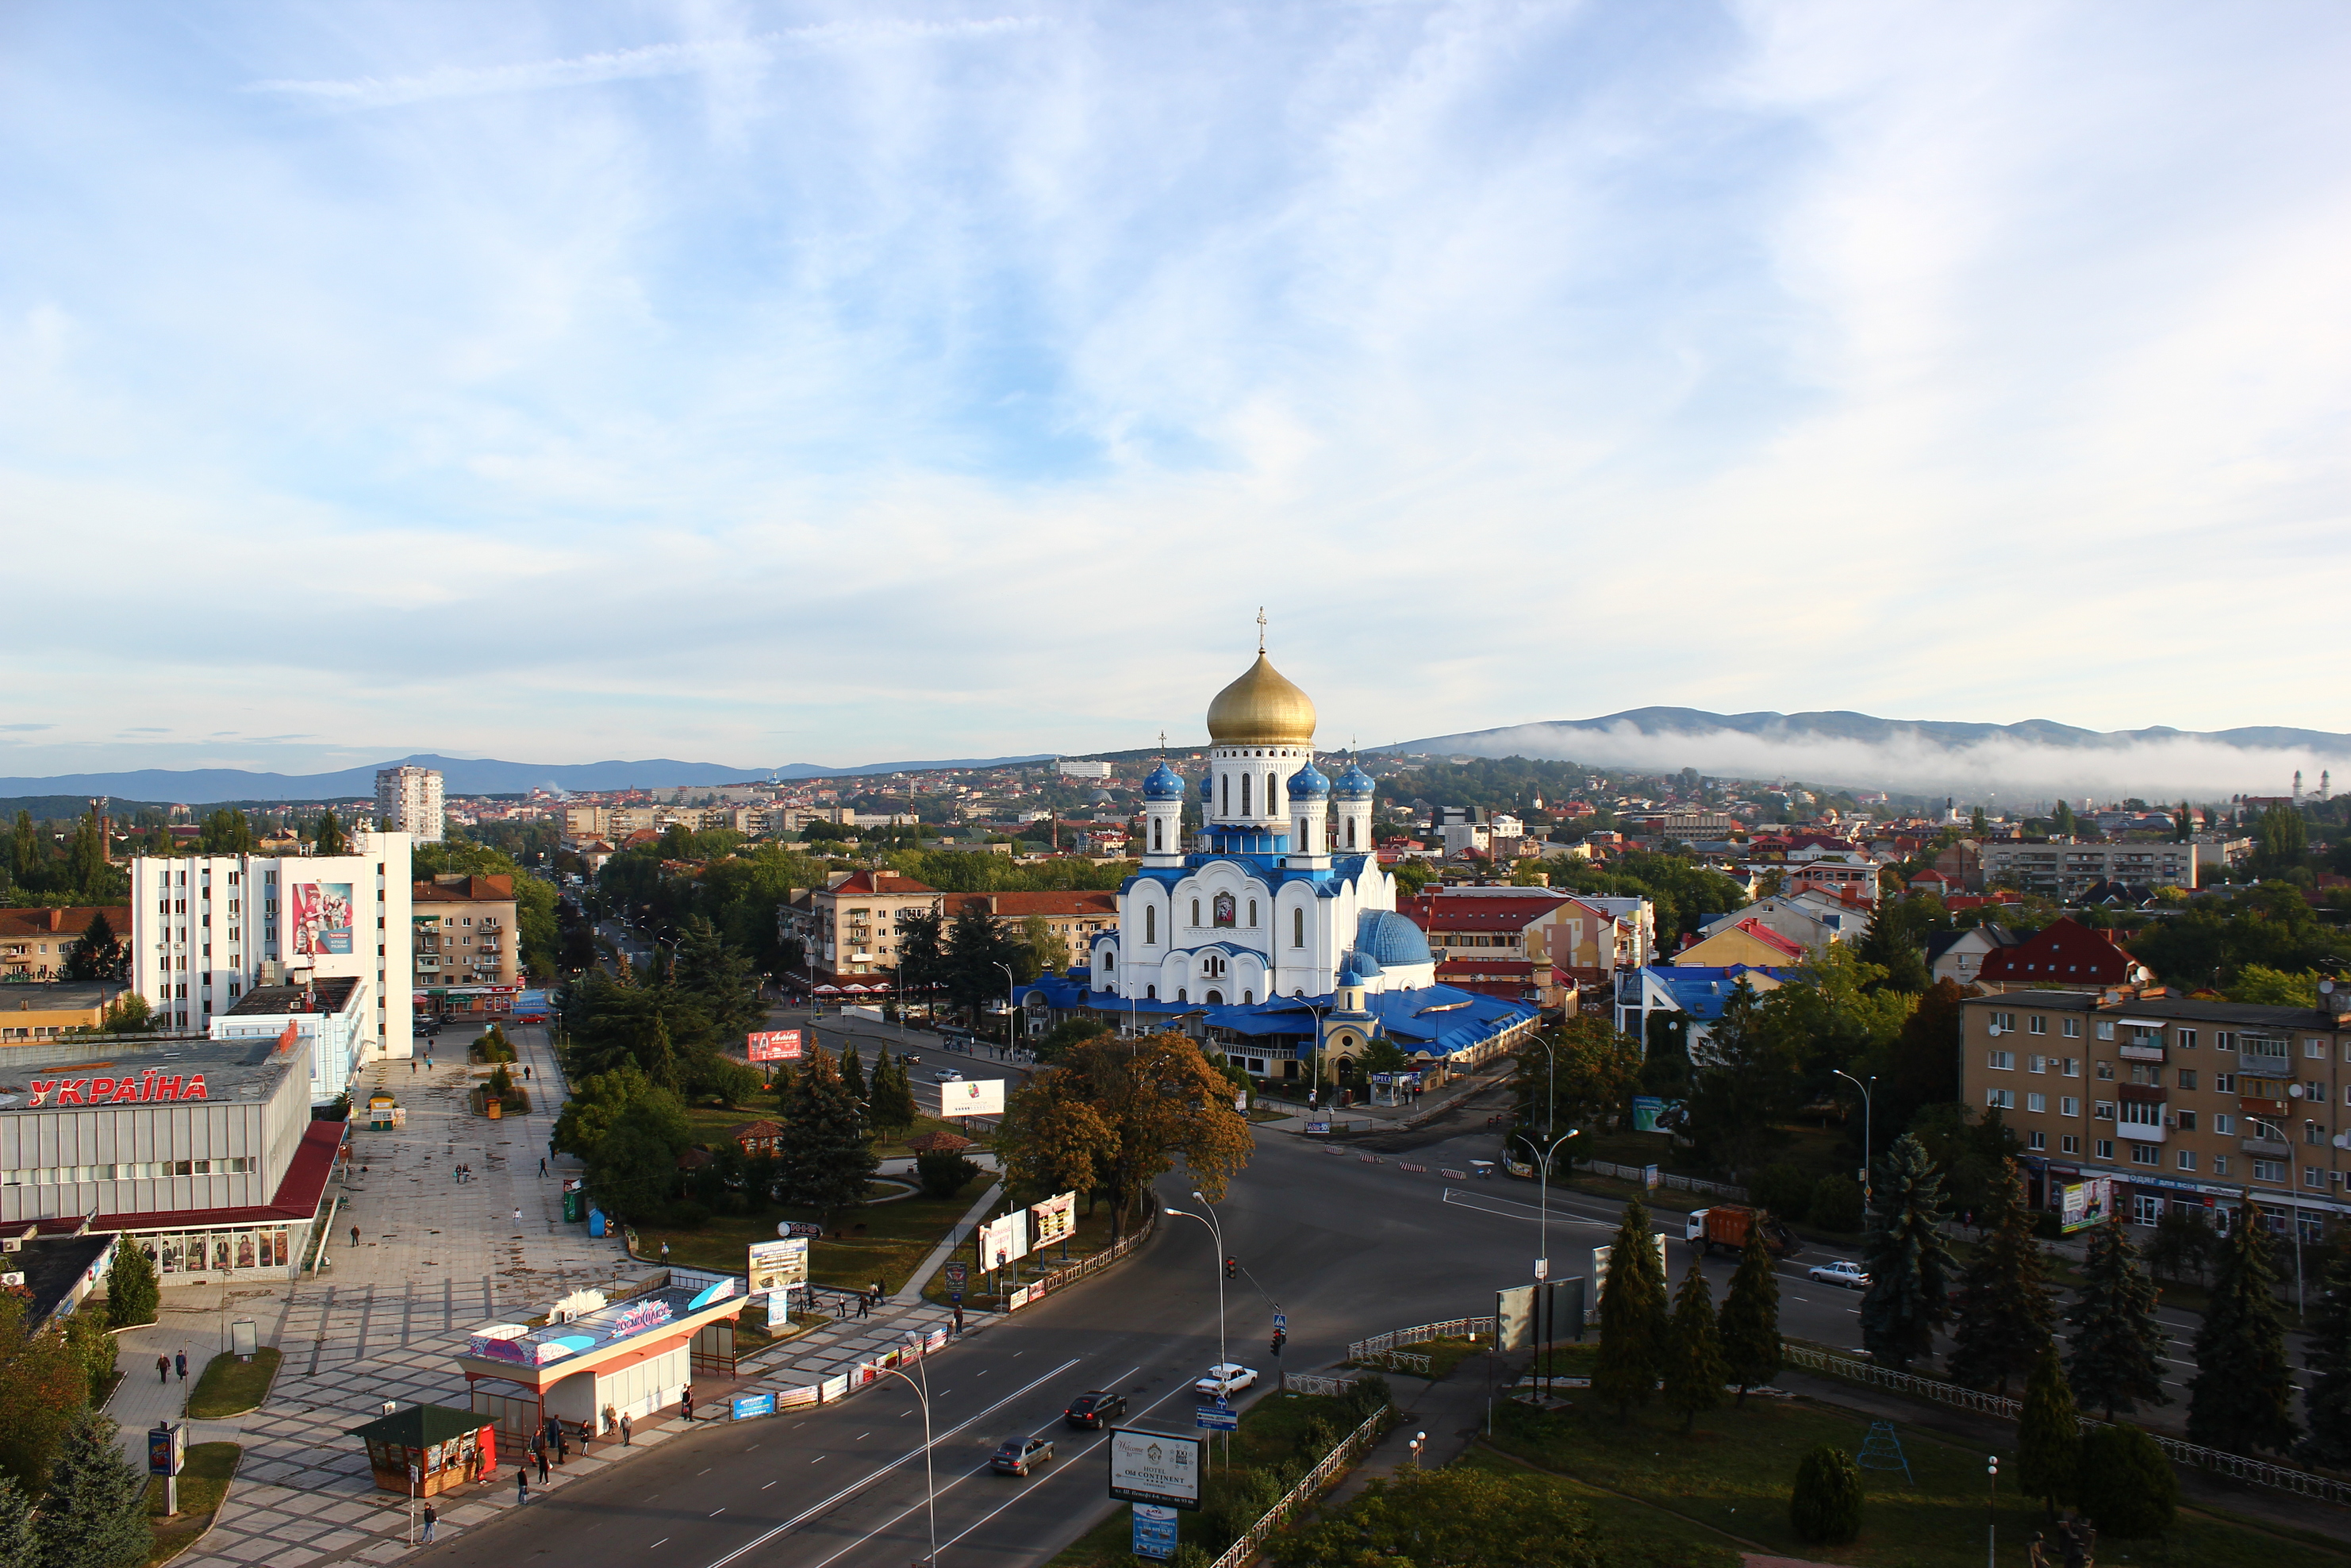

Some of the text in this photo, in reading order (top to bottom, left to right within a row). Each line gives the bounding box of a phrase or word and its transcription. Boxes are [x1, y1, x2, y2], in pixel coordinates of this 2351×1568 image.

[29, 1070, 208, 1106] УКРАЇНА
[2130, 1175, 2157, 1184] ОДЯГ
[1116, 1440, 1143, 1453] Welcome
[1143, 1466, 1166, 1474] HOTEL
[1138, 1471, 1185, 1484] CONTINENT
